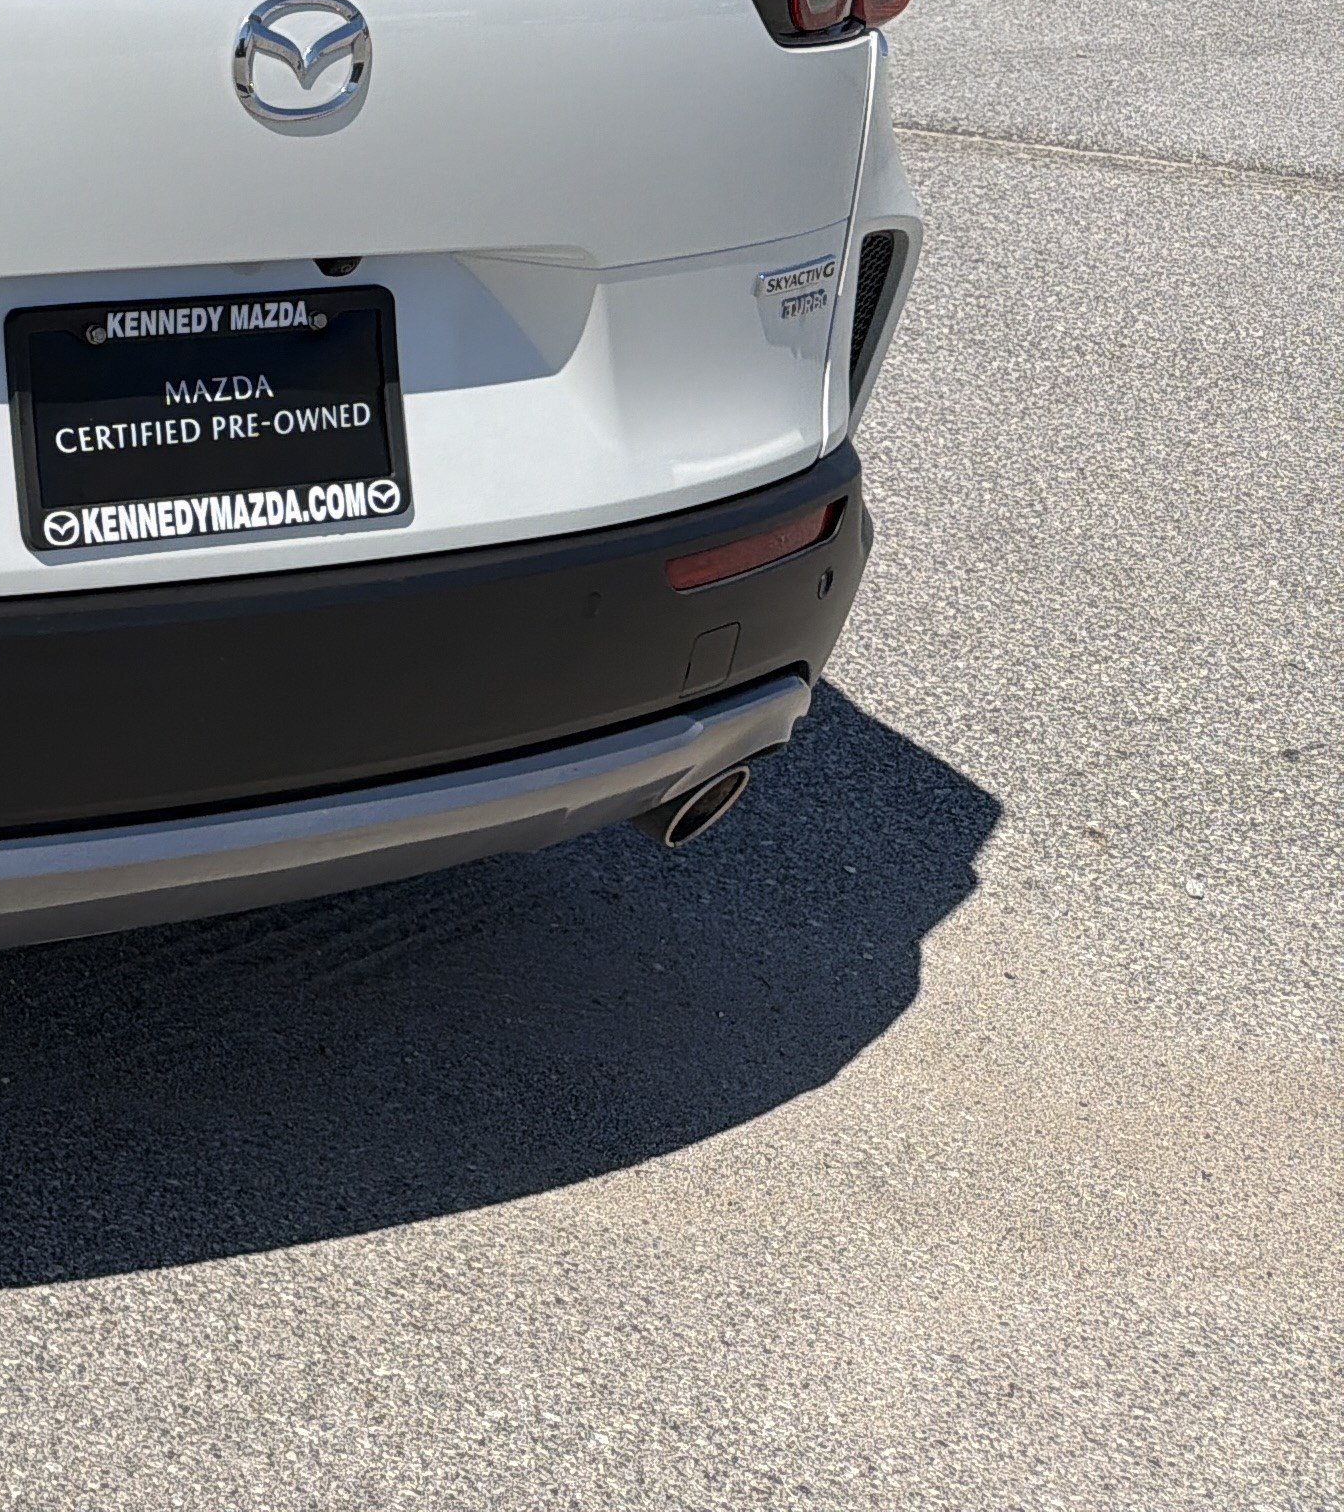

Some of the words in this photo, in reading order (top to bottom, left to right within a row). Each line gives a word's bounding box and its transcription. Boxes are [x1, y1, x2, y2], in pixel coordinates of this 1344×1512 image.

[106, 306, 223, 339] KENNEDY
[230, 300, 309, 331] MAZDA
[165, 375, 275, 406] MAZDA
[55, 418, 201, 455] CERTIFIED
[212, 402, 371, 441] PRE-OWNED
[81, 482, 367, 545] KENNEDYMAZDA.COM
